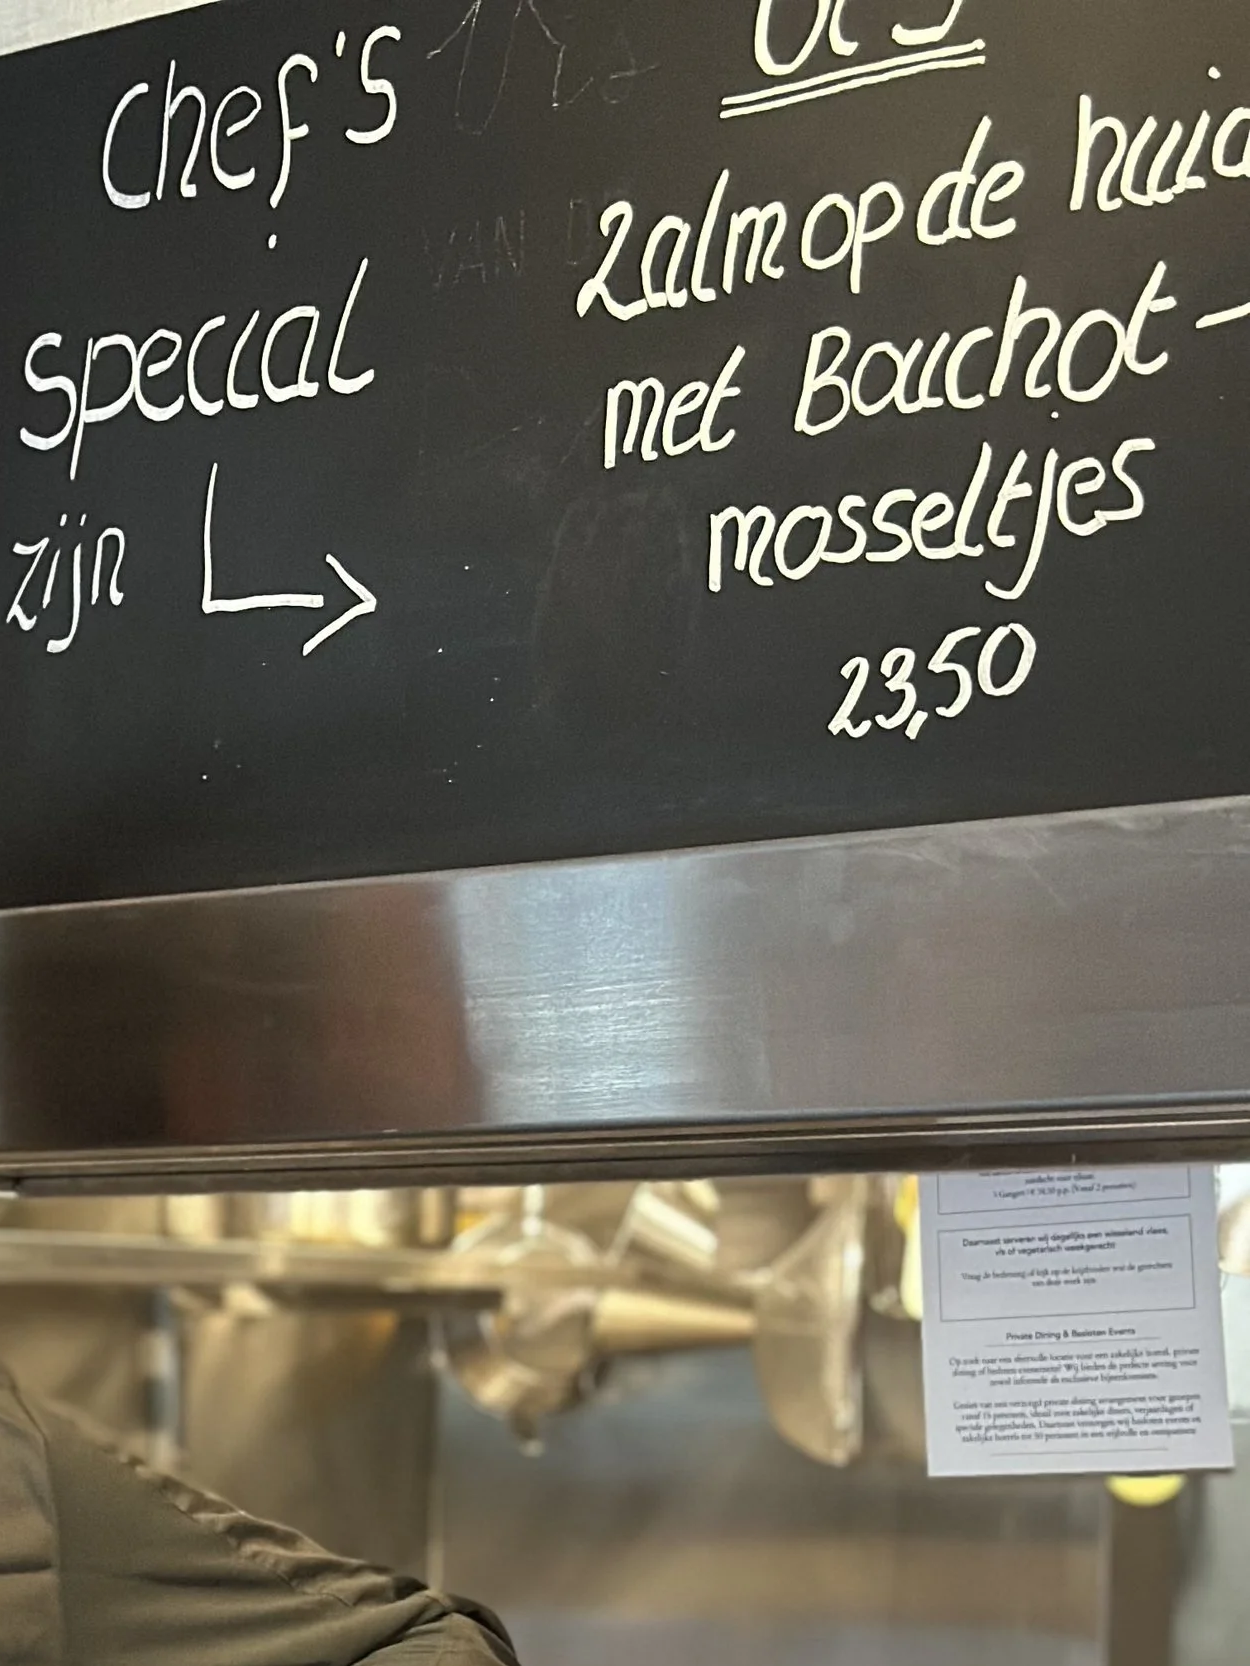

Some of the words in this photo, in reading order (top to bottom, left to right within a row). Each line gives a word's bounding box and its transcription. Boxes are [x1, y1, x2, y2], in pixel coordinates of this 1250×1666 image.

[802, 182, 904, 293] op
[917, 116, 1025, 245] de
[20, 234, 374, 480] special
[604, 345, 745, 469] met
[709, 411, 1155, 599] mosseltjes
[6, 514, 125, 653] zijn
[828, 623, 1036, 739] 23,50
[1006, 1331, 1032, 1340] Private
[1034, 1330, 1060, 1341] Dining
